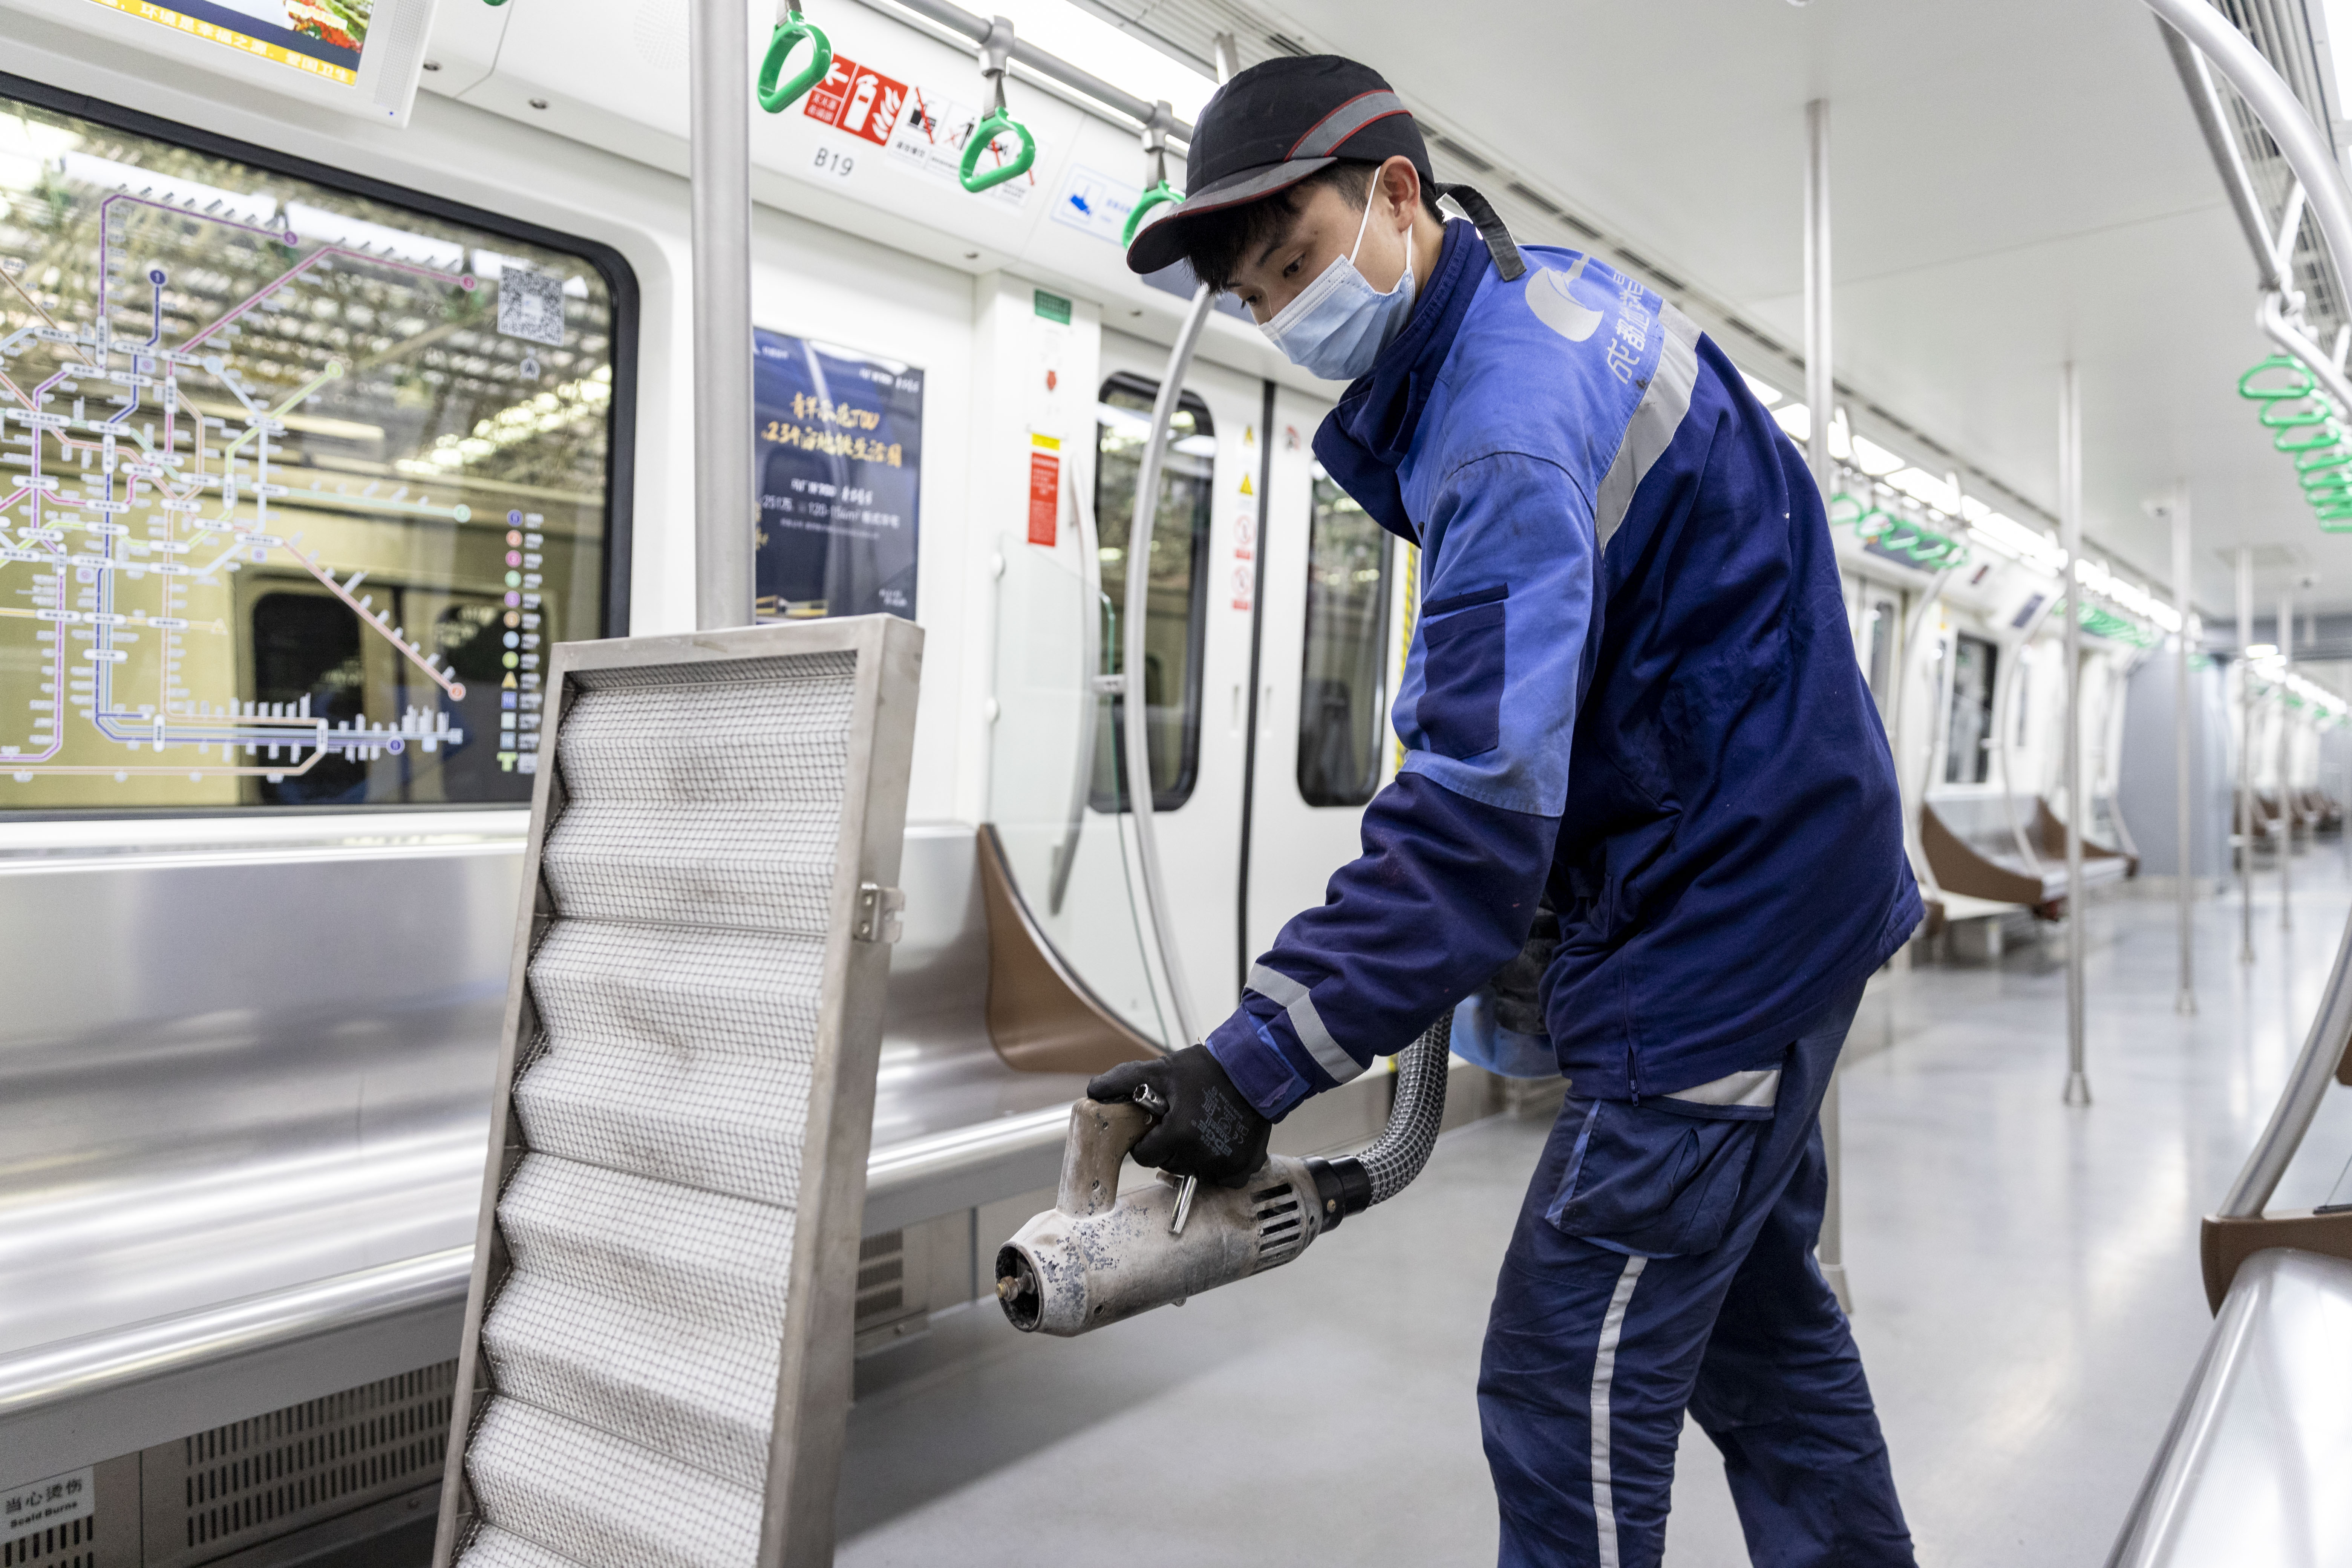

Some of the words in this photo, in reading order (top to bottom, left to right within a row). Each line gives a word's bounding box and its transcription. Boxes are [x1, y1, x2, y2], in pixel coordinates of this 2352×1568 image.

[814, 147, 854, 176] B19
[1197, 1119, 1233, 1157] EDGE
[1205, 1116, 1231, 1143] Ansell
